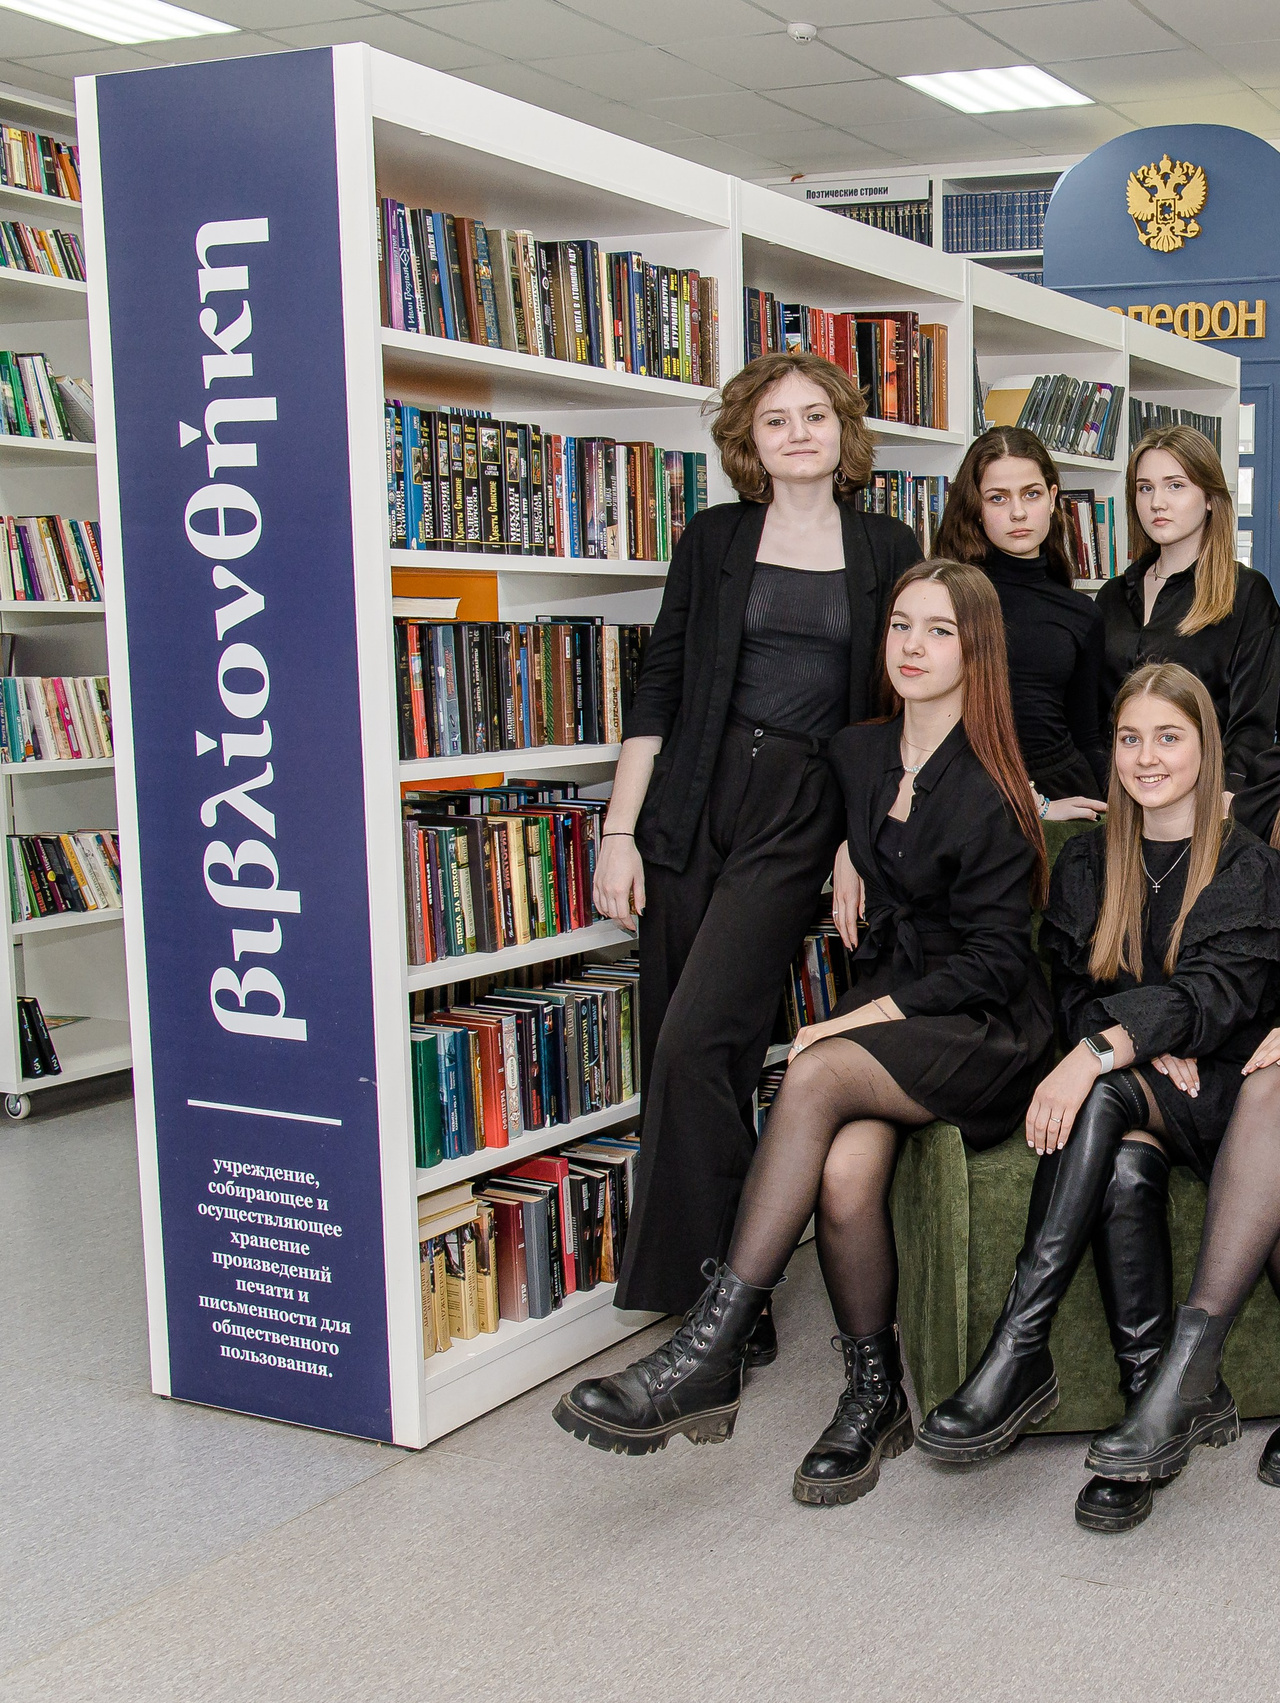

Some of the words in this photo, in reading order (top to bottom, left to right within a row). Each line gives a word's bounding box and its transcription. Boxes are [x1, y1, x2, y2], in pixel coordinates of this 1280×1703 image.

[806, 188, 858, 200] Поэтические
[860, 186, 889, 197] строки
[568, 248, 576, 263] АДУ
[570, 265, 580, 300] АТОМНОМ
[574, 310, 583, 332] ОХОТА
[670, 296, 678, 348] ШТУРМОВИК
[384, 418, 392, 448] ХМУРЫЙ
[440, 481, 449, 538] ГРИГОРИЙ
[454, 478, 463, 510] Саянские
[488, 480, 498, 513] Саянские
[610, 475, 618, 520] НЕРУШИМЫЙ
[455, 512, 466, 540] Хребты
[466, 496, 476, 540] ВАЛЕРИЙ
[489, 514, 500, 542] Хребты
[508, 487, 517, 542] МИХАИЛ
[571, 505, 579, 555] ЕКАТЕРИНА
[612, 686, 620, 728] ОТРЕЧЕНИЕ
[455, 915, 464, 945] ЭПОХА
[500, 1089, 508, 1130] ОФИЦЕРЫ
[212, 1157, 321, 1189] учреждение,
[207, 1179, 314, 1209] собирающее
[316, 1197, 329, 1212] и
[197, 1202, 343, 1238] осуществляющее
[230, 1229, 310, 1256] хранение
[211, 1249, 333, 1284] произведений
[235, 1276, 294, 1301] печати
[297, 1288, 310, 1303] и
[437, 1254, 446, 1321] ЧУЖЕСТРАНКА
[198, 1293, 317, 1328] письменности
[320, 1316, 352, 1335] для
[211, 1318, 340, 1357] общественного
[219, 1342, 334, 1378] пользования.
